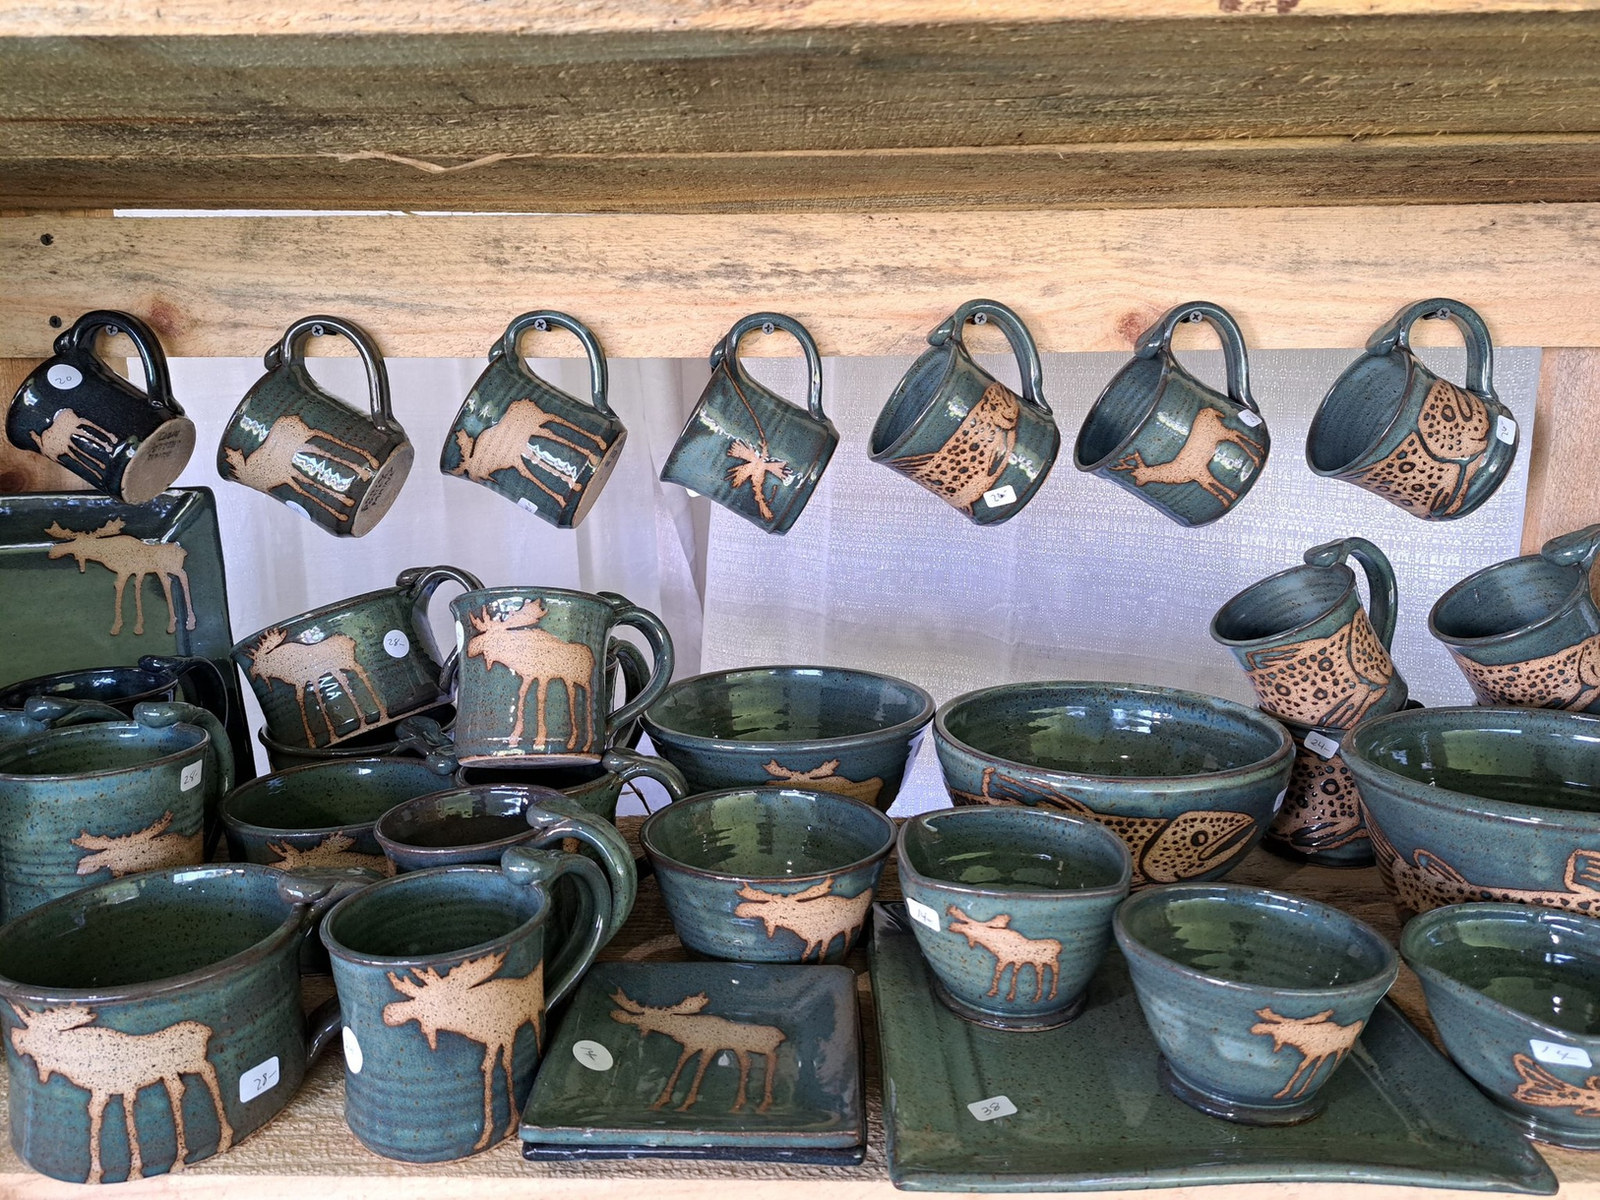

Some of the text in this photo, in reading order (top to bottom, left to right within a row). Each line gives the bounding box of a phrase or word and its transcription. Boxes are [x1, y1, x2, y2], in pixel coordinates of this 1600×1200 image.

[54, 376, 73, 385] 20
[387, 637, 406, 647] 28-
[1311, 738, 1332, 752] 24-
[252, 1070, 278, 1091] 28-
[981, 1102, 1001, 1116] 38
